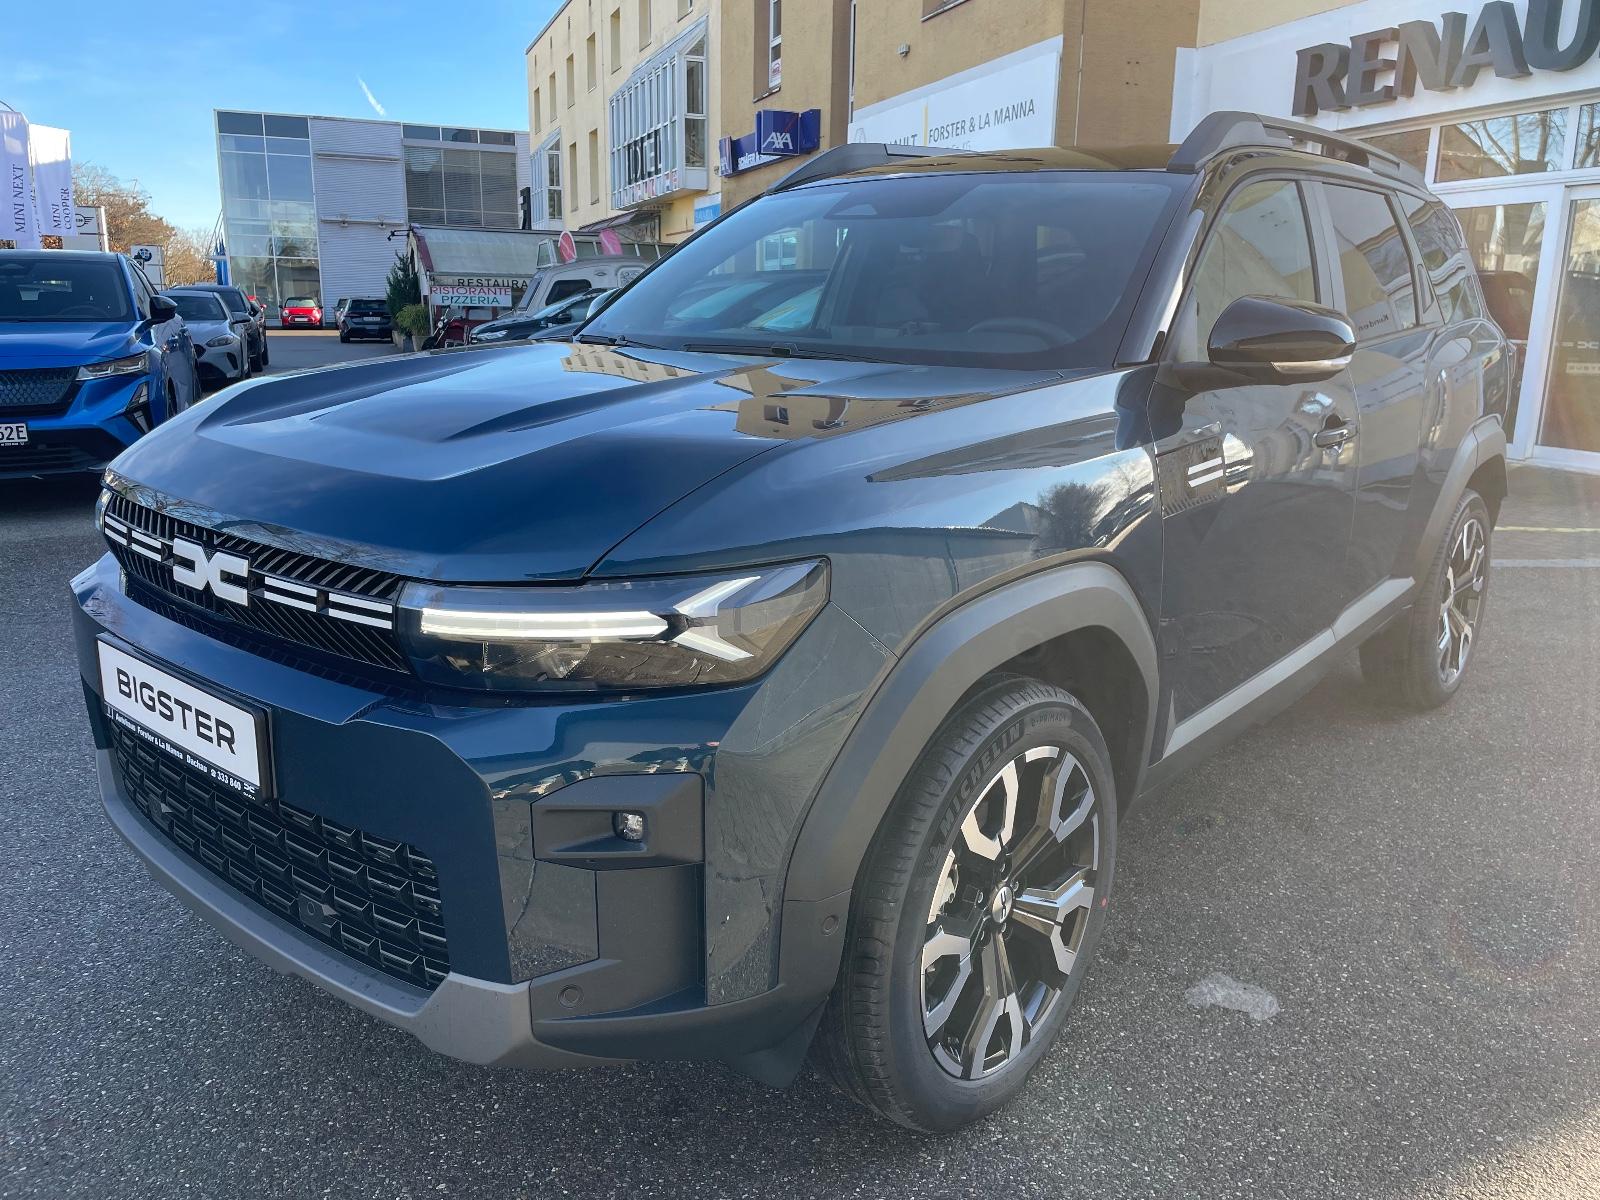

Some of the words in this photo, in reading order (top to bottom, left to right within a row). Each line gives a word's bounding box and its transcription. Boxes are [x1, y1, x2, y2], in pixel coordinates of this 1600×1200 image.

[1292, 0, 1600, 116] RENAU
[929, 119, 966, 144] FORSTER
[968, 116, 976, 133] &
[978, 112, 991, 130] LA
[993, 98, 1035, 127] MANNA
[762, 131, 793, 150] AXA
[12, 163, 24, 198] NEXT
[13, 203, 26, 233] MINI
[51, 203, 62, 229] MINI
[60, 187, 72, 230] COOPER
[430, 286, 511, 296] RISTORANTE
[441, 295, 500, 305] PIZZERIA
[457, 278, 528, 289] RESTAURA
[116, 667, 236, 755] BIGSTER
[137, 726, 154, 743] Forster
[158, 738, 165, 750] La
[165, 742, 183, 760] Manna
[186, 754, 208, 773] Dachau
[217, 770, 229, 784] 333
[229, 777, 242, 791] 840
[939, 722, 1021, 838] MICHELIN
